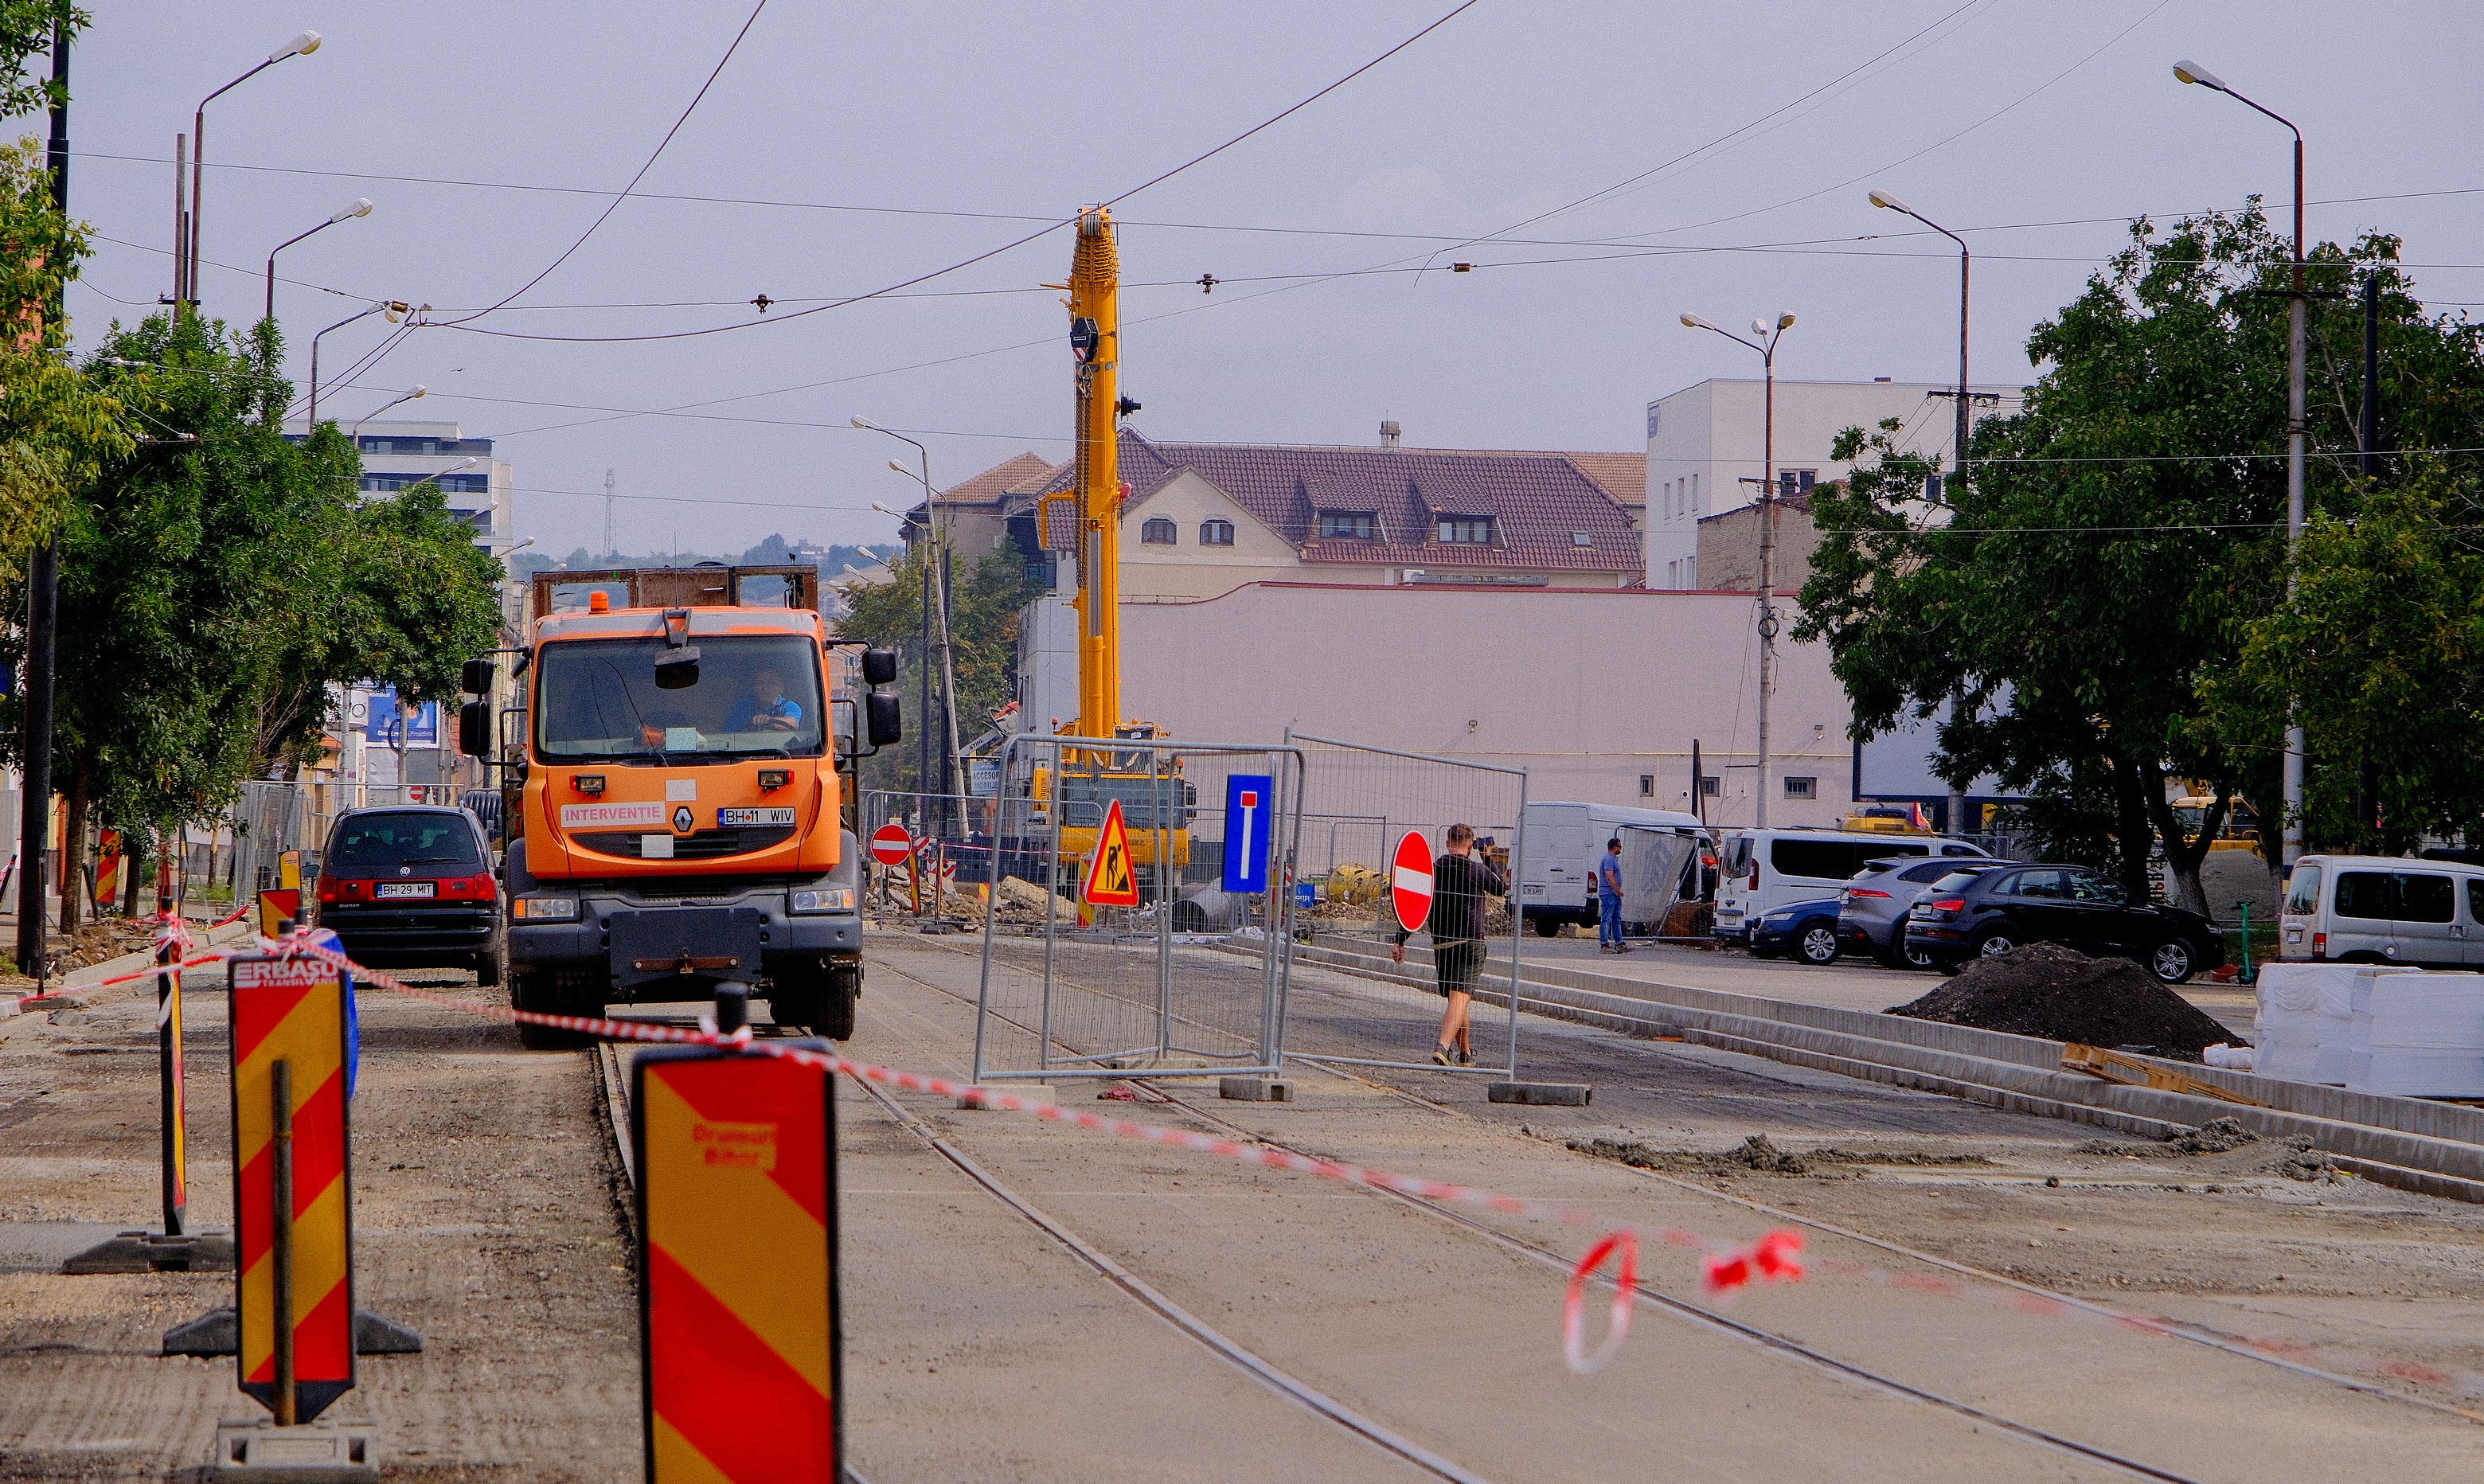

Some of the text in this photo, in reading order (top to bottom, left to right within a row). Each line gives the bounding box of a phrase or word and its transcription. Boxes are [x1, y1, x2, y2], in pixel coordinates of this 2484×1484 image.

[969, 739, 984, 751] STIHL
[973, 771, 999, 779] ACCESOR
[974, 781, 998, 790] MOBILIE
[564, 806, 661, 822] INTERVENȚIE
[726, 810, 792, 822] BH 11 WIV
[383, 885, 432, 895] BH 29 MIT
